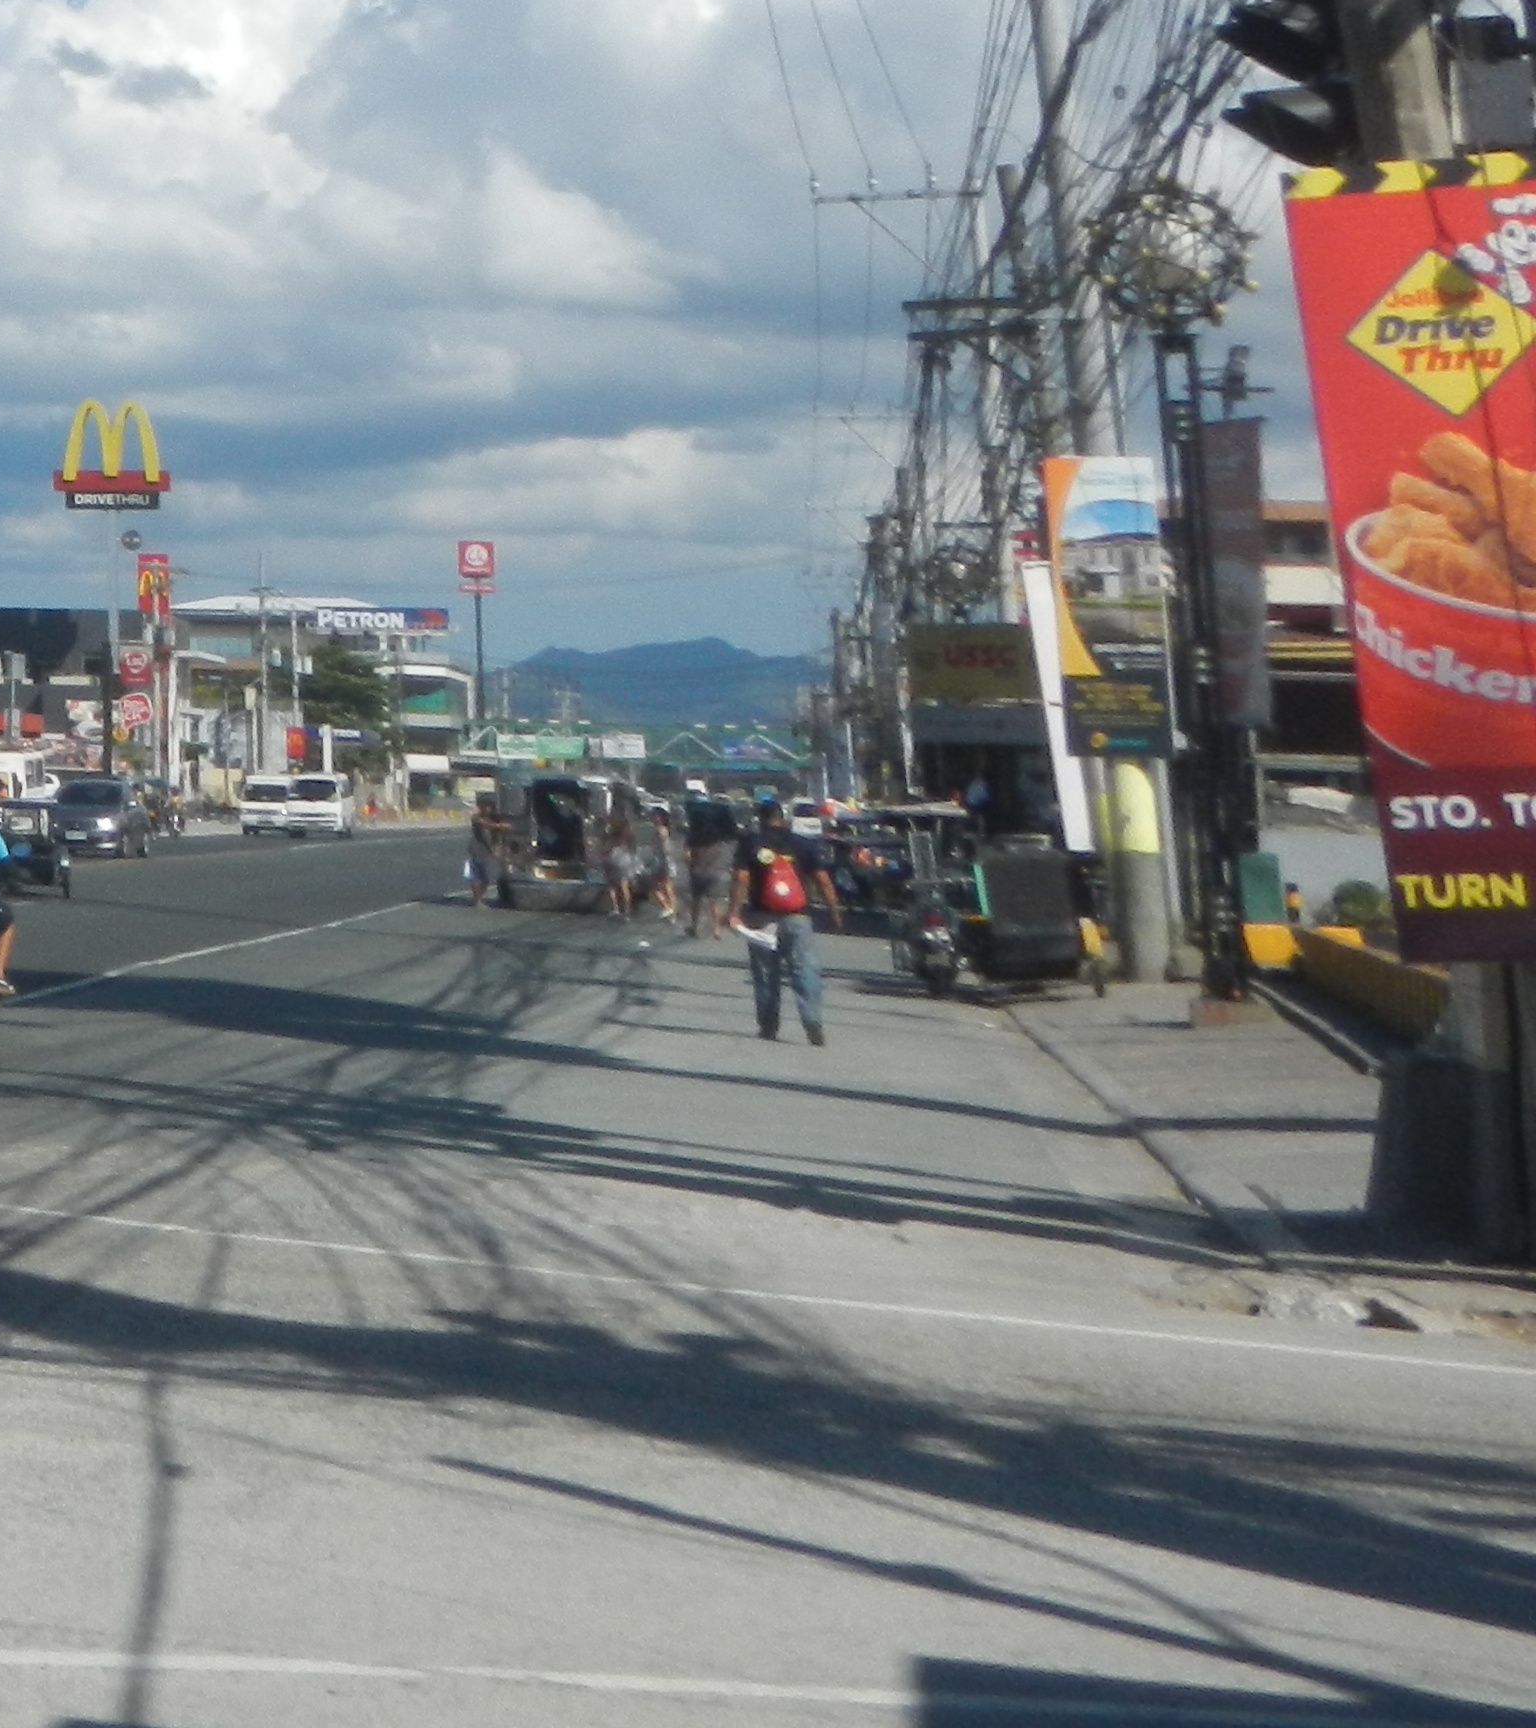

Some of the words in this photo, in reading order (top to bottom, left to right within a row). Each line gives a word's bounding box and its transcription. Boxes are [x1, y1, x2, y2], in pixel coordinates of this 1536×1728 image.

[1374, 315, 1496, 345] Drive
[1398, 343, 1504, 373] Thru
[317, 608, 405, 630] PETRON
[318, 728, 361, 738] PTRON
[1388, 794, 1493, 830] STO.
[1503, 792, 1536, 828] T
[1395, 872, 1529, 910] TURN
